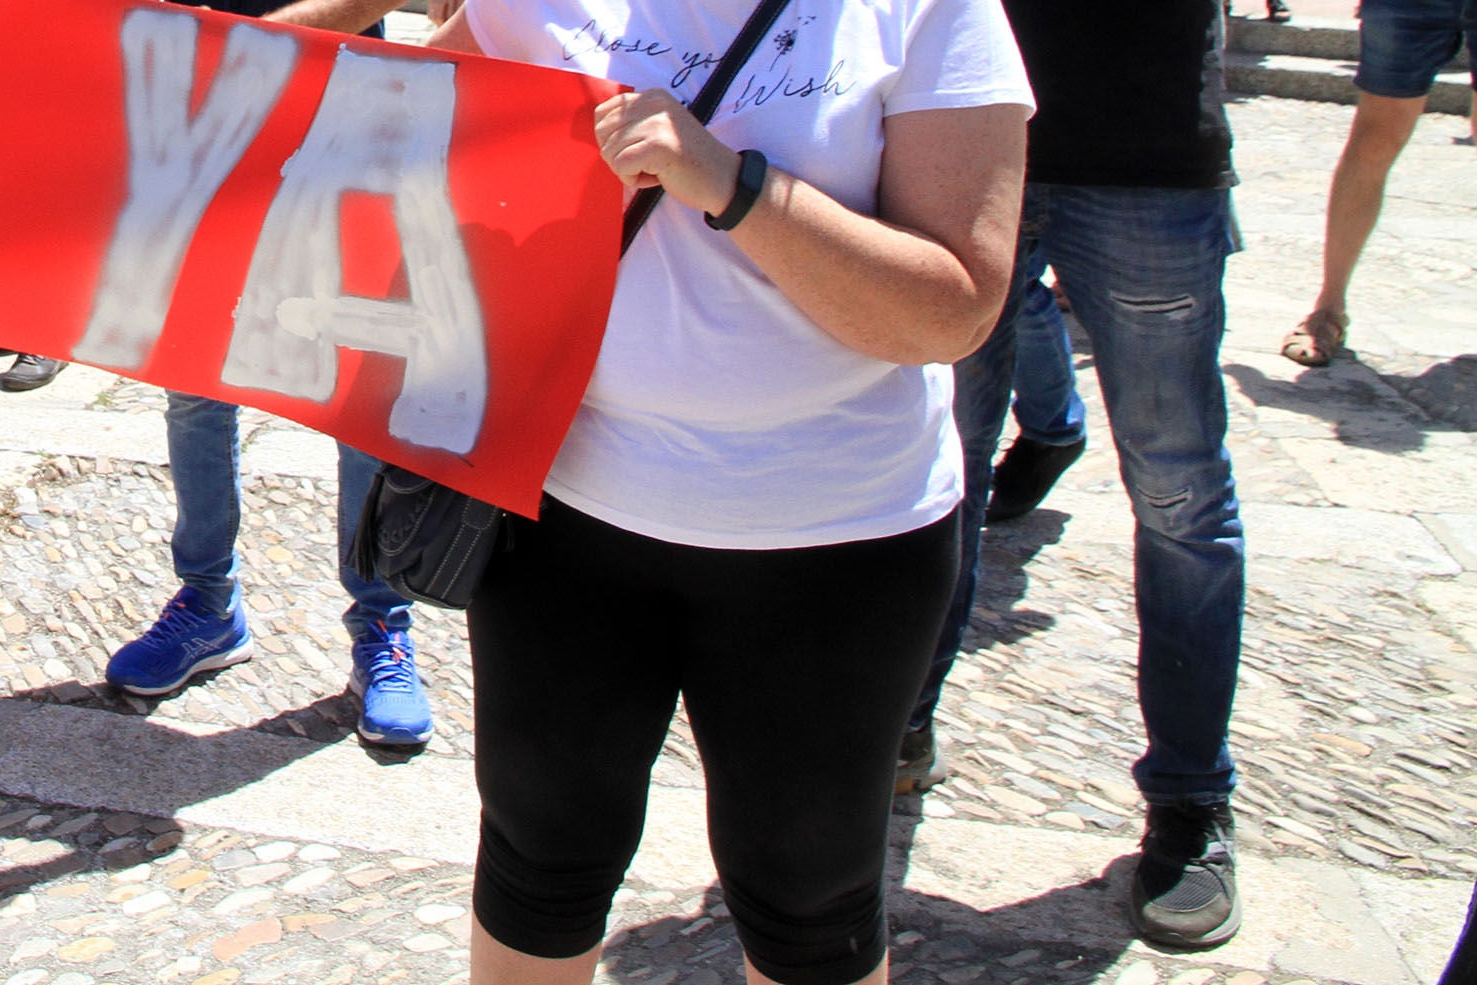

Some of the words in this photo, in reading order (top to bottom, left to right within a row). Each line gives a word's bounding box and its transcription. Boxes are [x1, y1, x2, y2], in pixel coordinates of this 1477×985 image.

[563, 19, 671, 61] Close
[734, 59, 856, 113] Wish
[71, 9, 490, 456] YA
